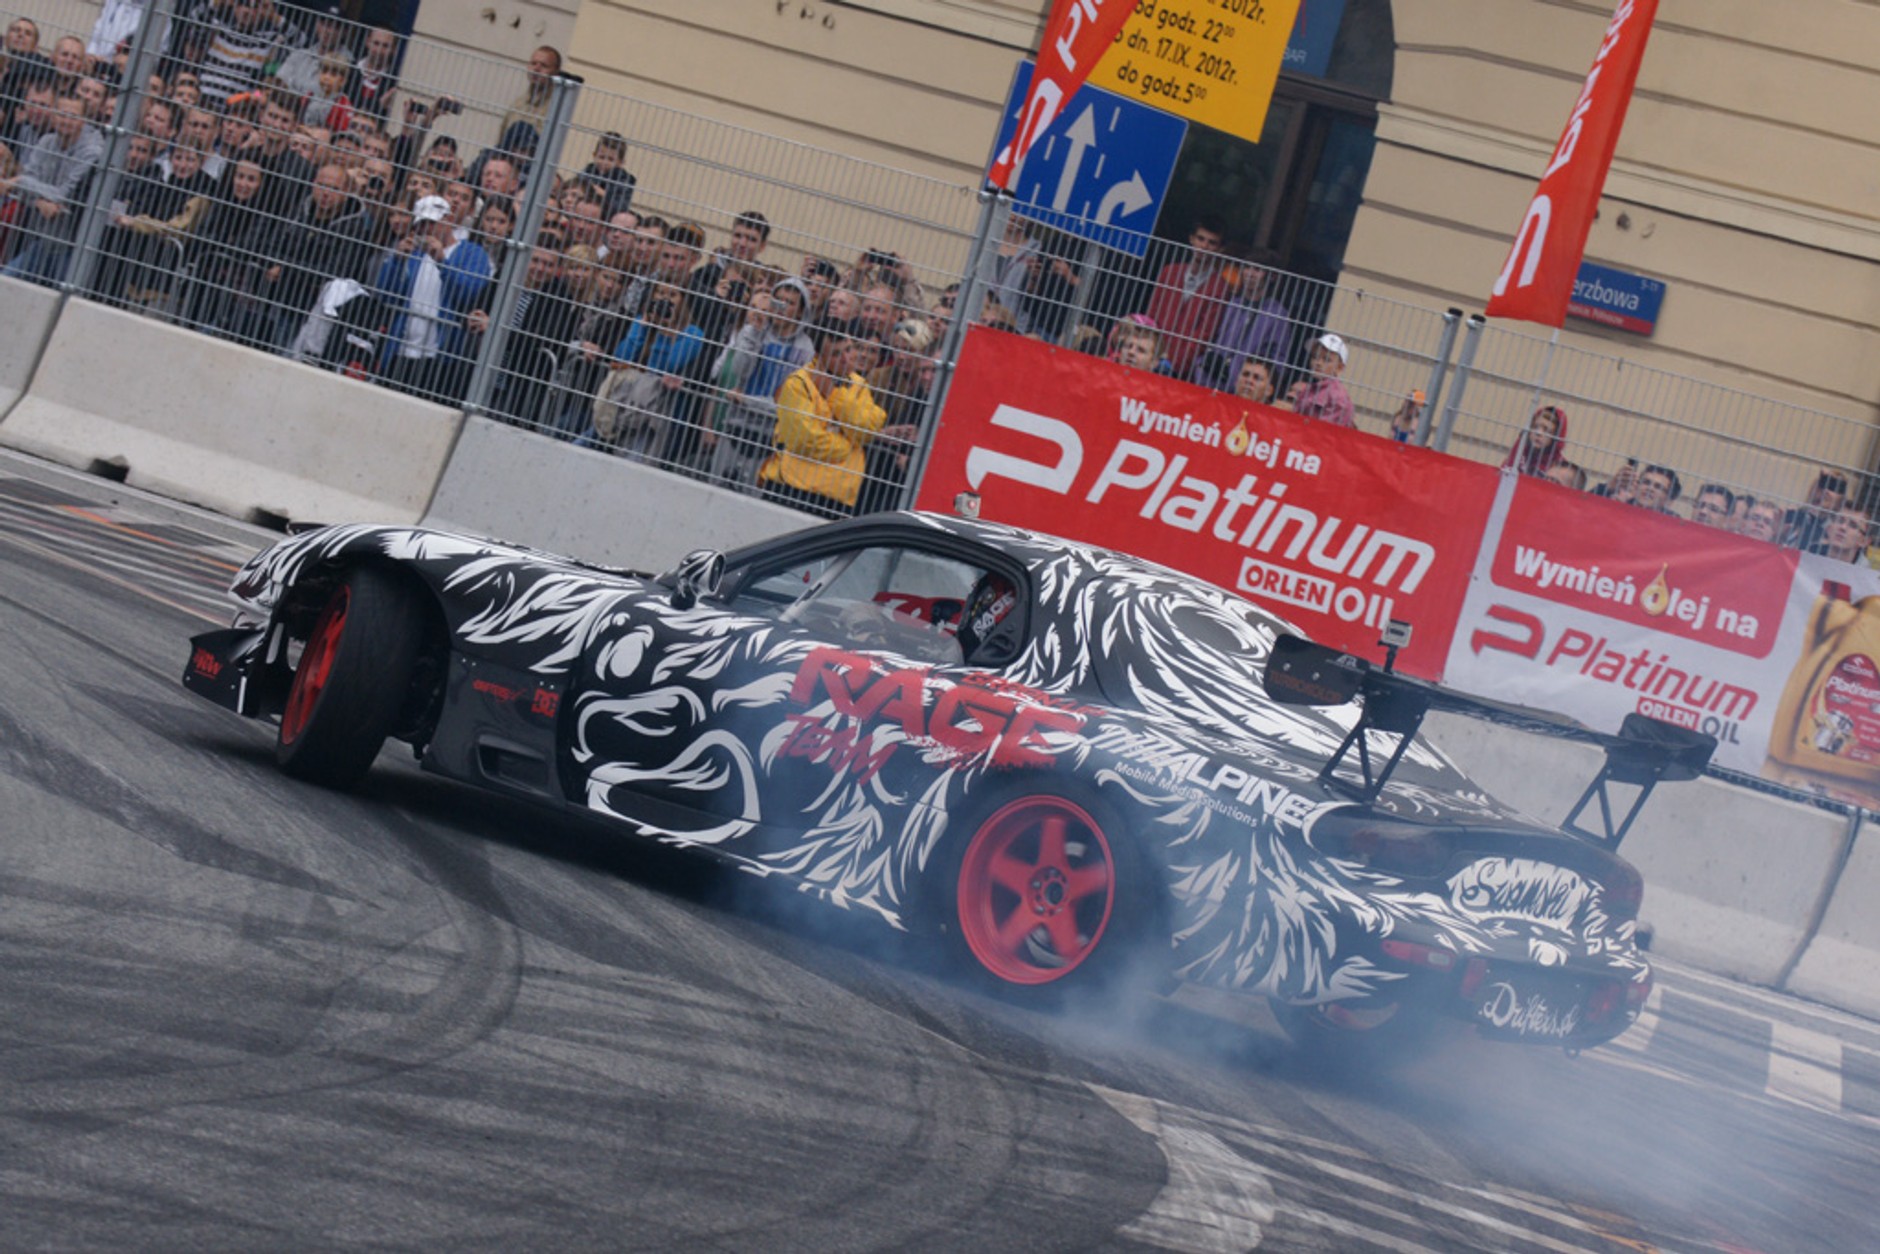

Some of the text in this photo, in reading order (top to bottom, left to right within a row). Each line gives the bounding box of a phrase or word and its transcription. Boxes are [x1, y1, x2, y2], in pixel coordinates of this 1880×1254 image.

[1127, 28, 1150, 54] dn.
[1195, 51, 1238, 86] 2012r.
[1157, 9, 1197, 36] godz.
[1117, 60, 1138, 84] do
[1570, 278, 1640, 311] erzbowa
[1119, 396, 1221, 447] Wymień
[1285, 448, 1321, 475] na
[1086, 438, 1436, 594] Platinum
[1244, 563, 1329, 608] ORLEN
[1514, 545, 1636, 605] Wymień
[1715, 607, 1759, 640] na
[789, 645, 1087, 768] RAGE
[1546, 628, 1759, 721] Platinum
[775, 712, 899, 786] TEAM
[1639, 701, 1741, 746] ORLEN OIL
[1113, 760, 1157, 785] Mobile
[1200, 792, 1258, 827] Solutions
[1150, 740, 1318, 830] ALPINE
